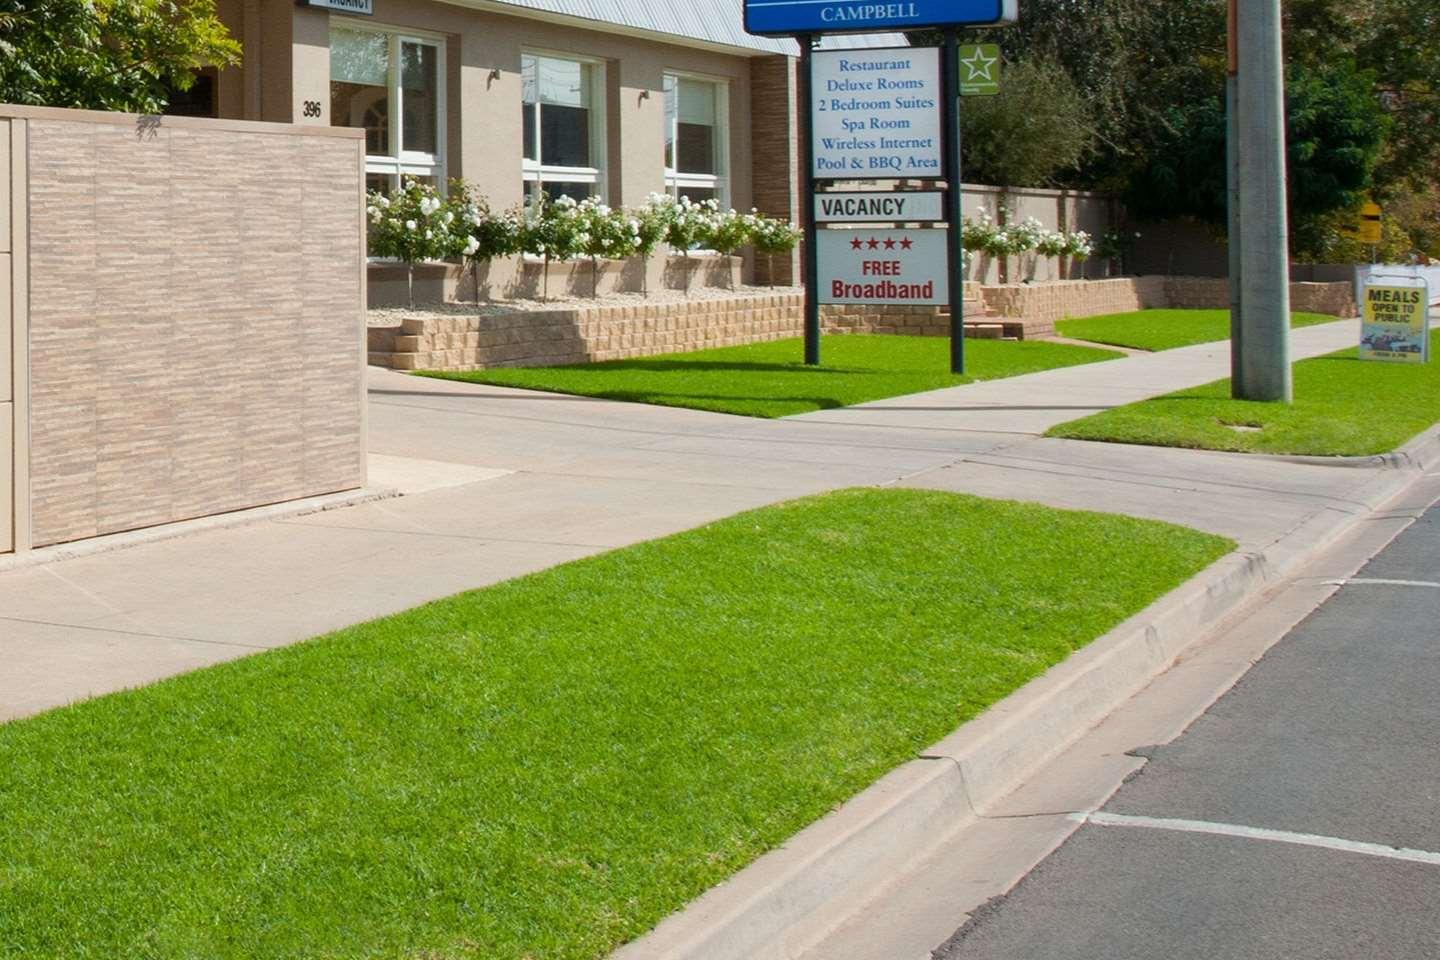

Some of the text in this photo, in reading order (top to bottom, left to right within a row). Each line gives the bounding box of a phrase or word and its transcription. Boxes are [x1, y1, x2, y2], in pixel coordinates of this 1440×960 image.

[820, 3, 920, 22] CAMPBELL
[839, 59, 911, 72] Restaurant
[827, 78, 924, 92] Deluxe Rooms
[303, 100, 321, 118] 396
[819, 96, 935, 111] 2 Bedroom Suites
[841, 117, 911, 133] Spa Room
[821, 137, 932, 150] Wireless Internet
[817, 156, 938, 171] Pool & BBQ Area
[821, 198, 906, 216] VACANCY
[862, 260, 901, 276] FREE
[831, 280, 933, 299] Broadband
[1368, 290, 1419, 303] MEALS
[1372, 303, 1414, 313] OPEN TO
[1375, 313, 1410, 322] PUBLIC
